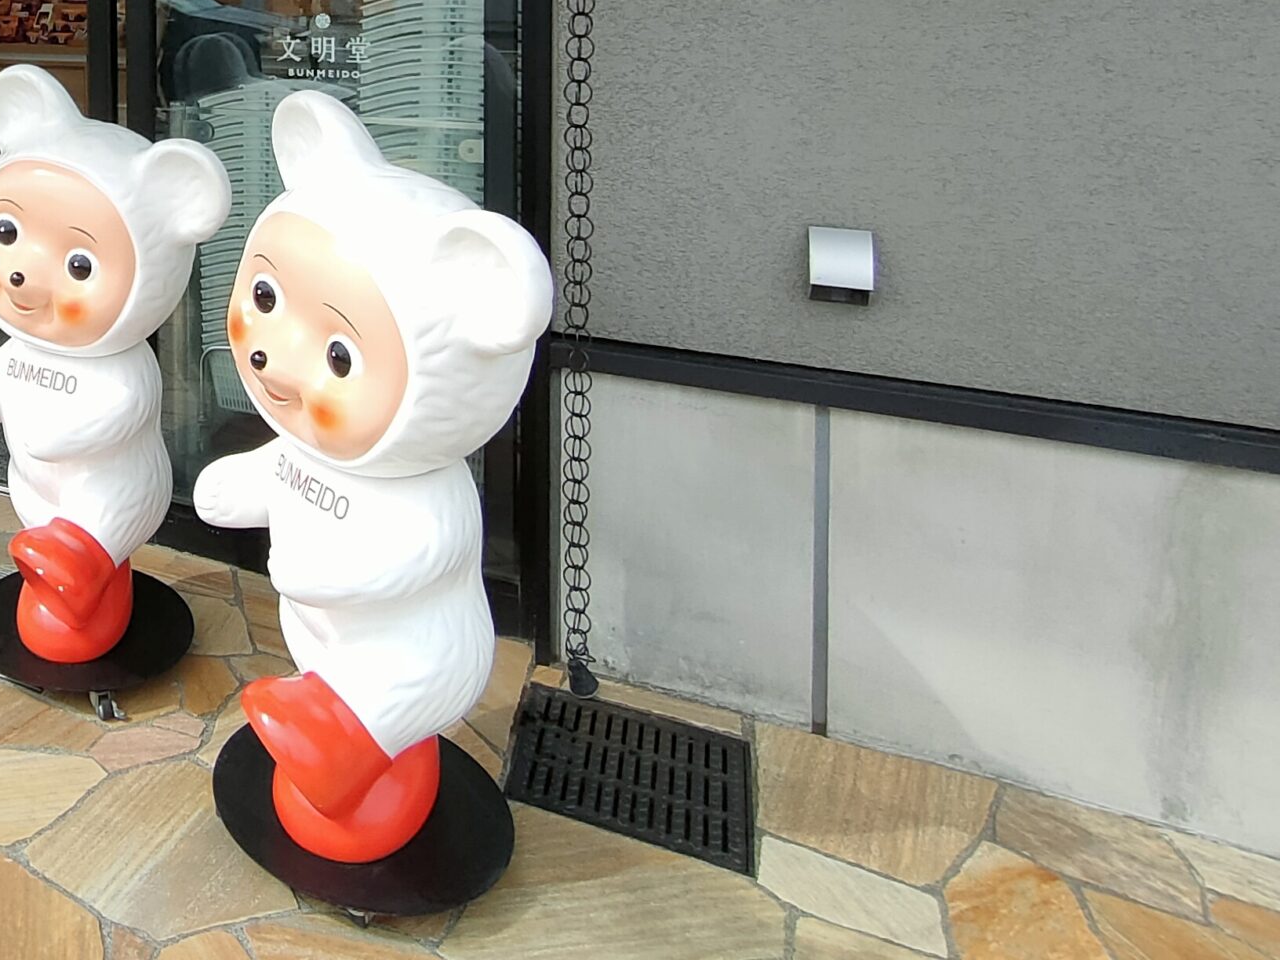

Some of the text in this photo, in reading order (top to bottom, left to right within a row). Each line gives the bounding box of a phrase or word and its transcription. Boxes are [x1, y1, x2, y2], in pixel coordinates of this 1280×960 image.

[276, 35, 371, 64] 文明堂
[287, 68, 361, 79] BUNMEIDO
[6, 357, 78, 396] BUNMEIDO
[274, 452, 350, 520] BUNMEIDO
